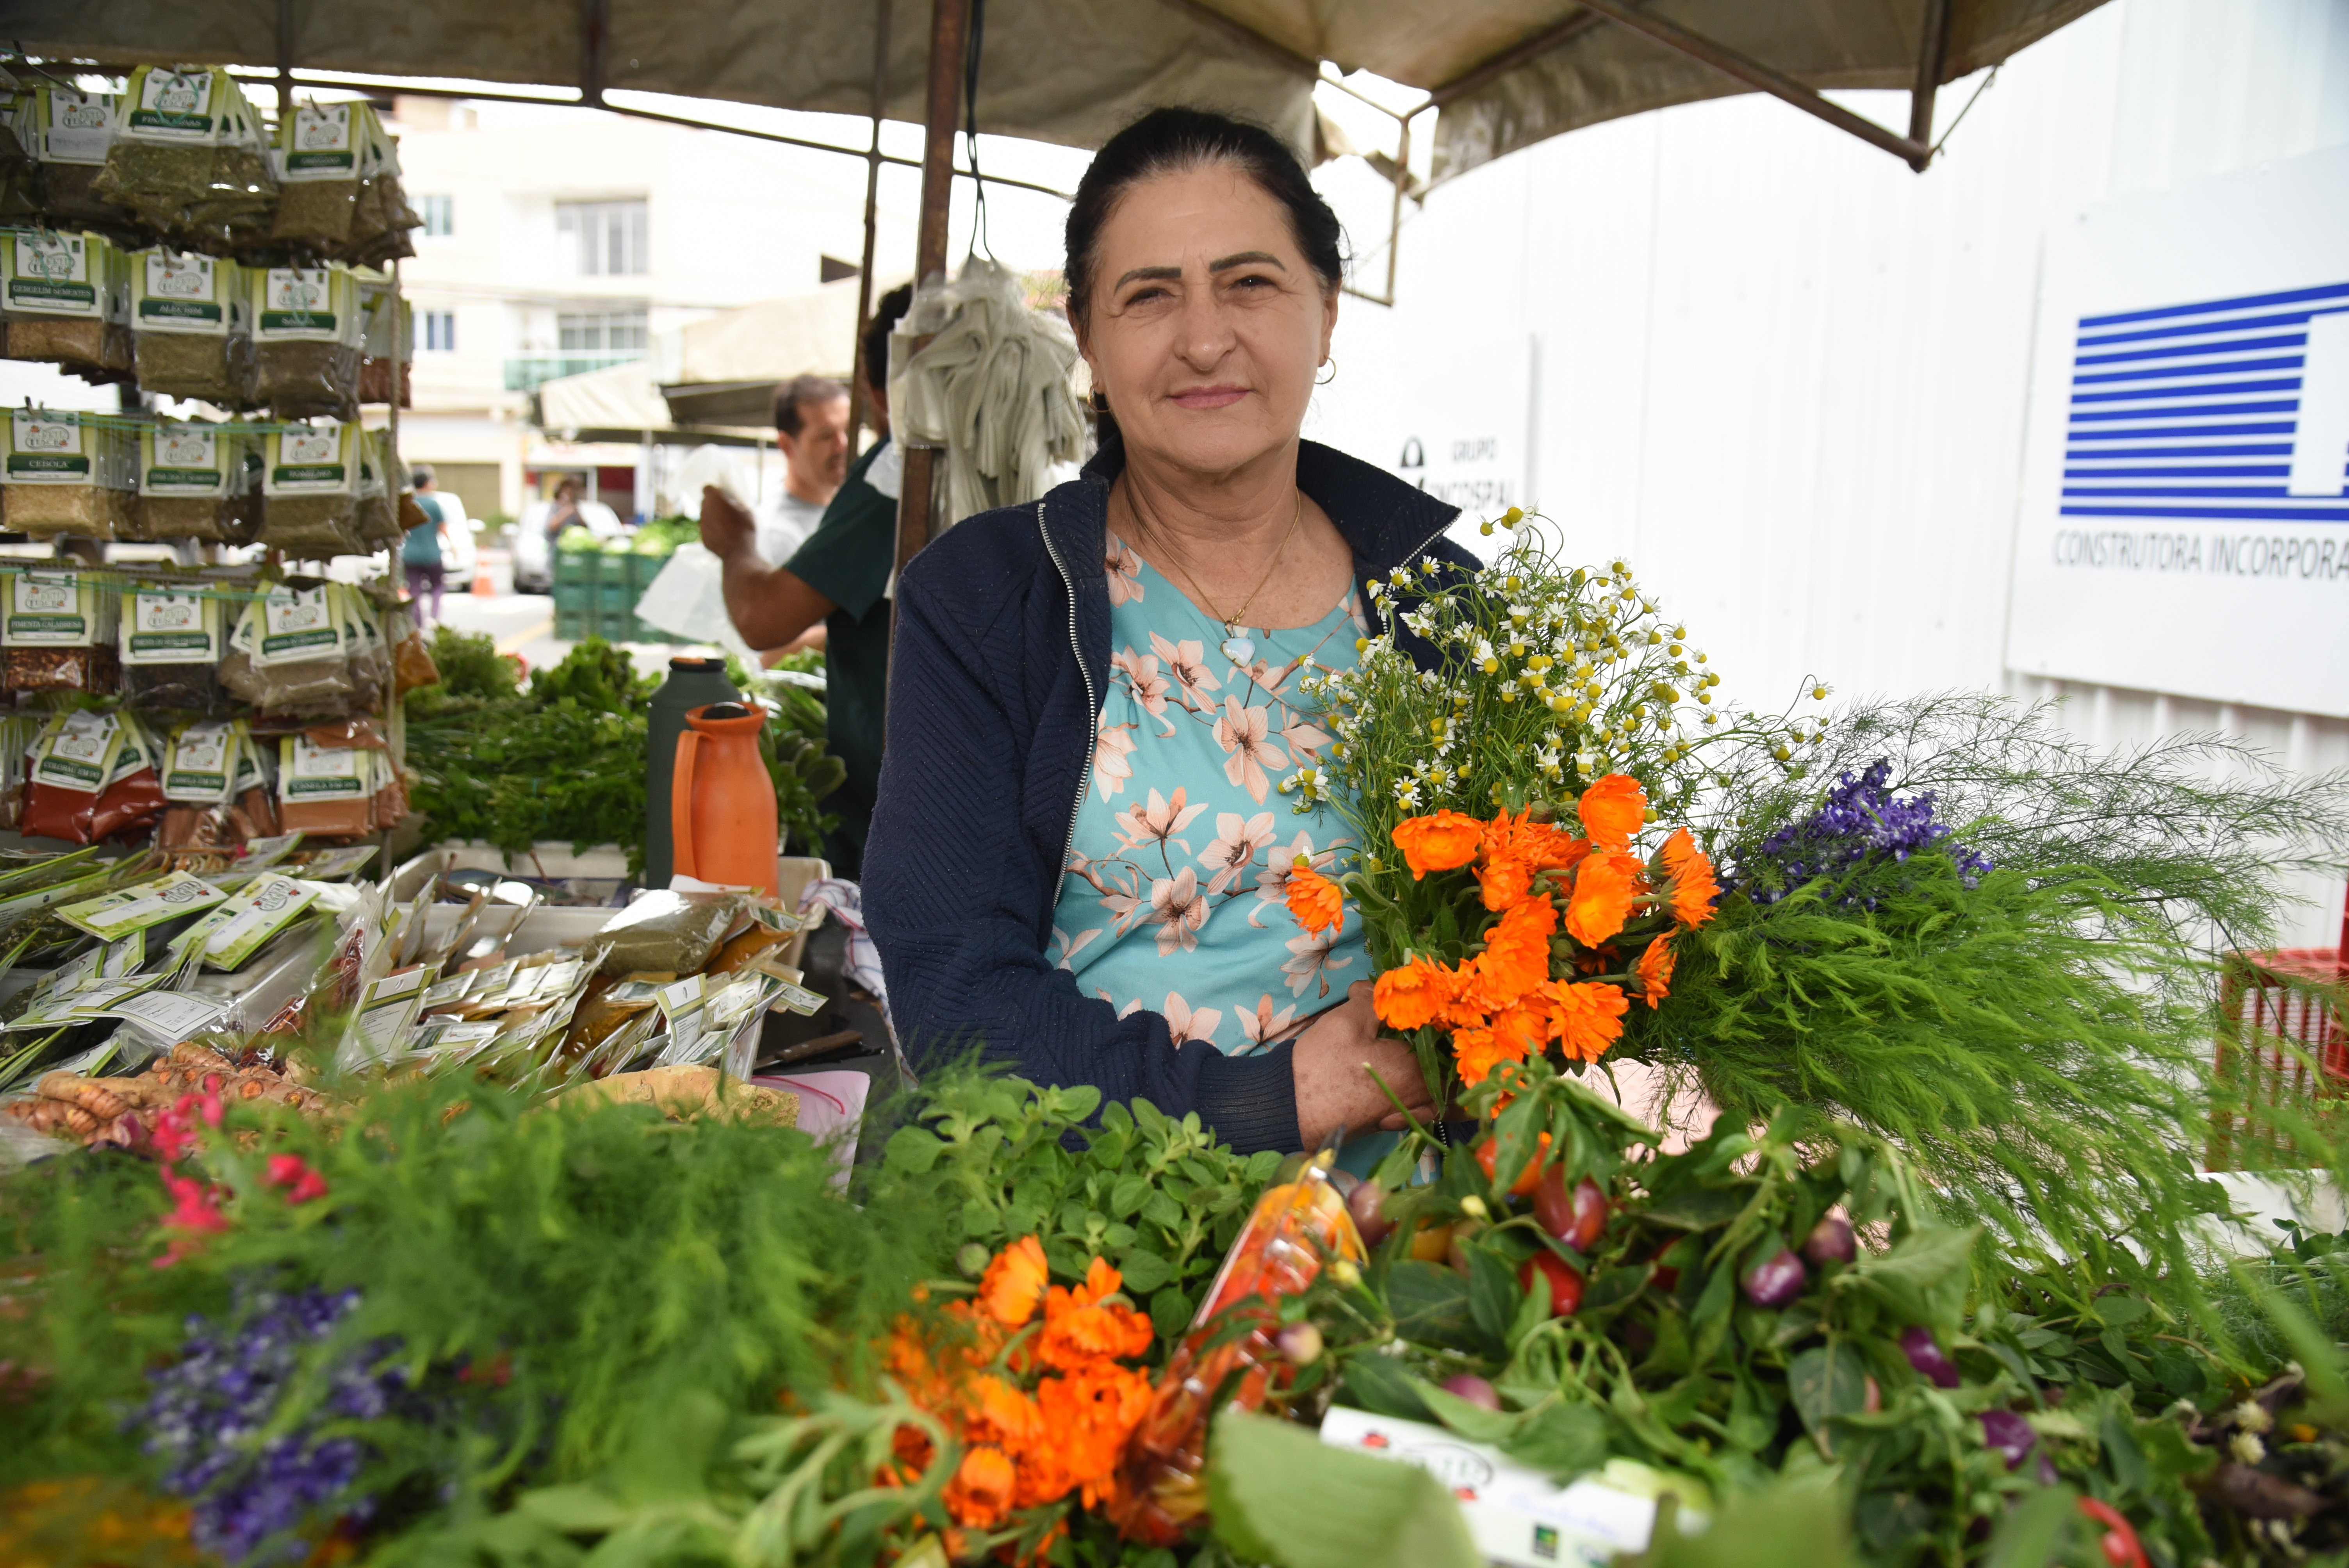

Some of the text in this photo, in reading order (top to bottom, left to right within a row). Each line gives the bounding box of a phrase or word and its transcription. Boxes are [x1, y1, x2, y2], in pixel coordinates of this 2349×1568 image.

[13, 284, 91, 296] GERGELIM SEMENTES
[1451, 438, 1497, 462] GRUPO
[29, 460, 68, 468] CEBOLA
[2052, 529, 2202, 573] CONSTRUTORA
